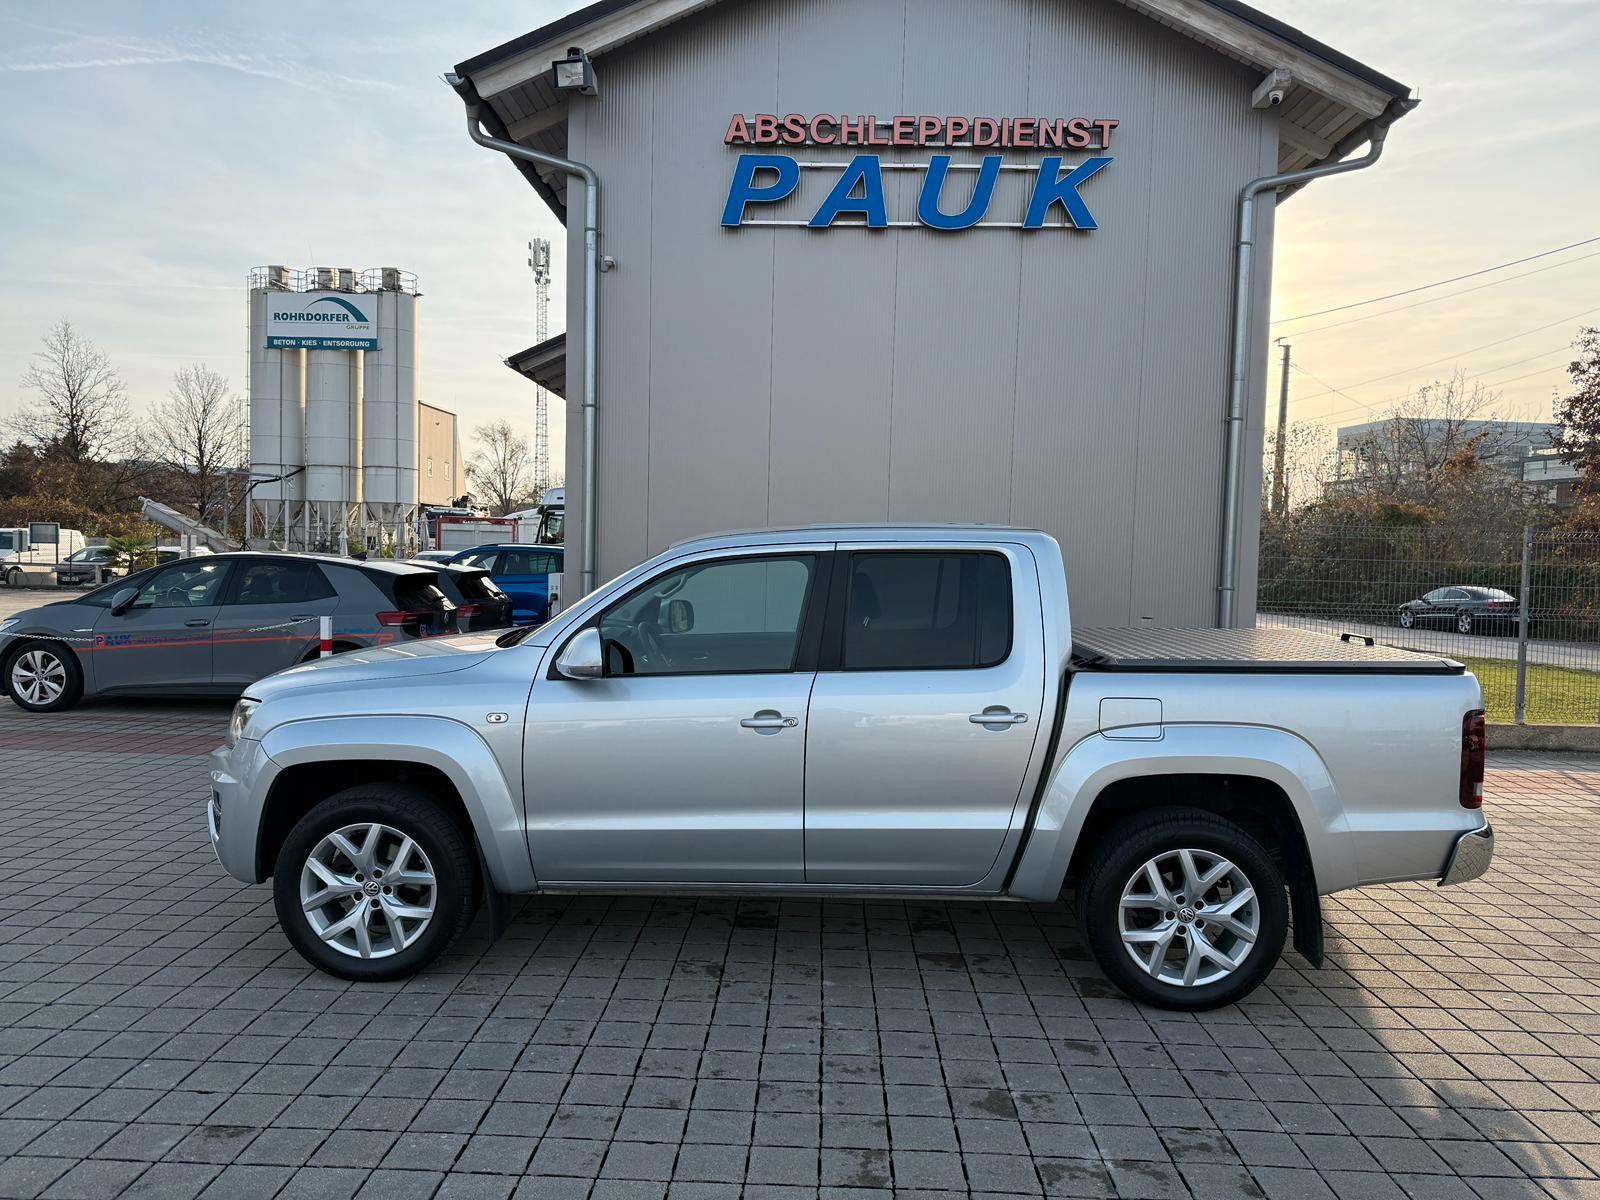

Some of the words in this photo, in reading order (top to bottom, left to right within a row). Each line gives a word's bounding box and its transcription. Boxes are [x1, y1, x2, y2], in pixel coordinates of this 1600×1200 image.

[724, 113, 1119, 149] ABSCHLEPPDIENST
[720, 153, 1115, 230] PAUK
[273, 312, 350, 322] ROHRDORFER
